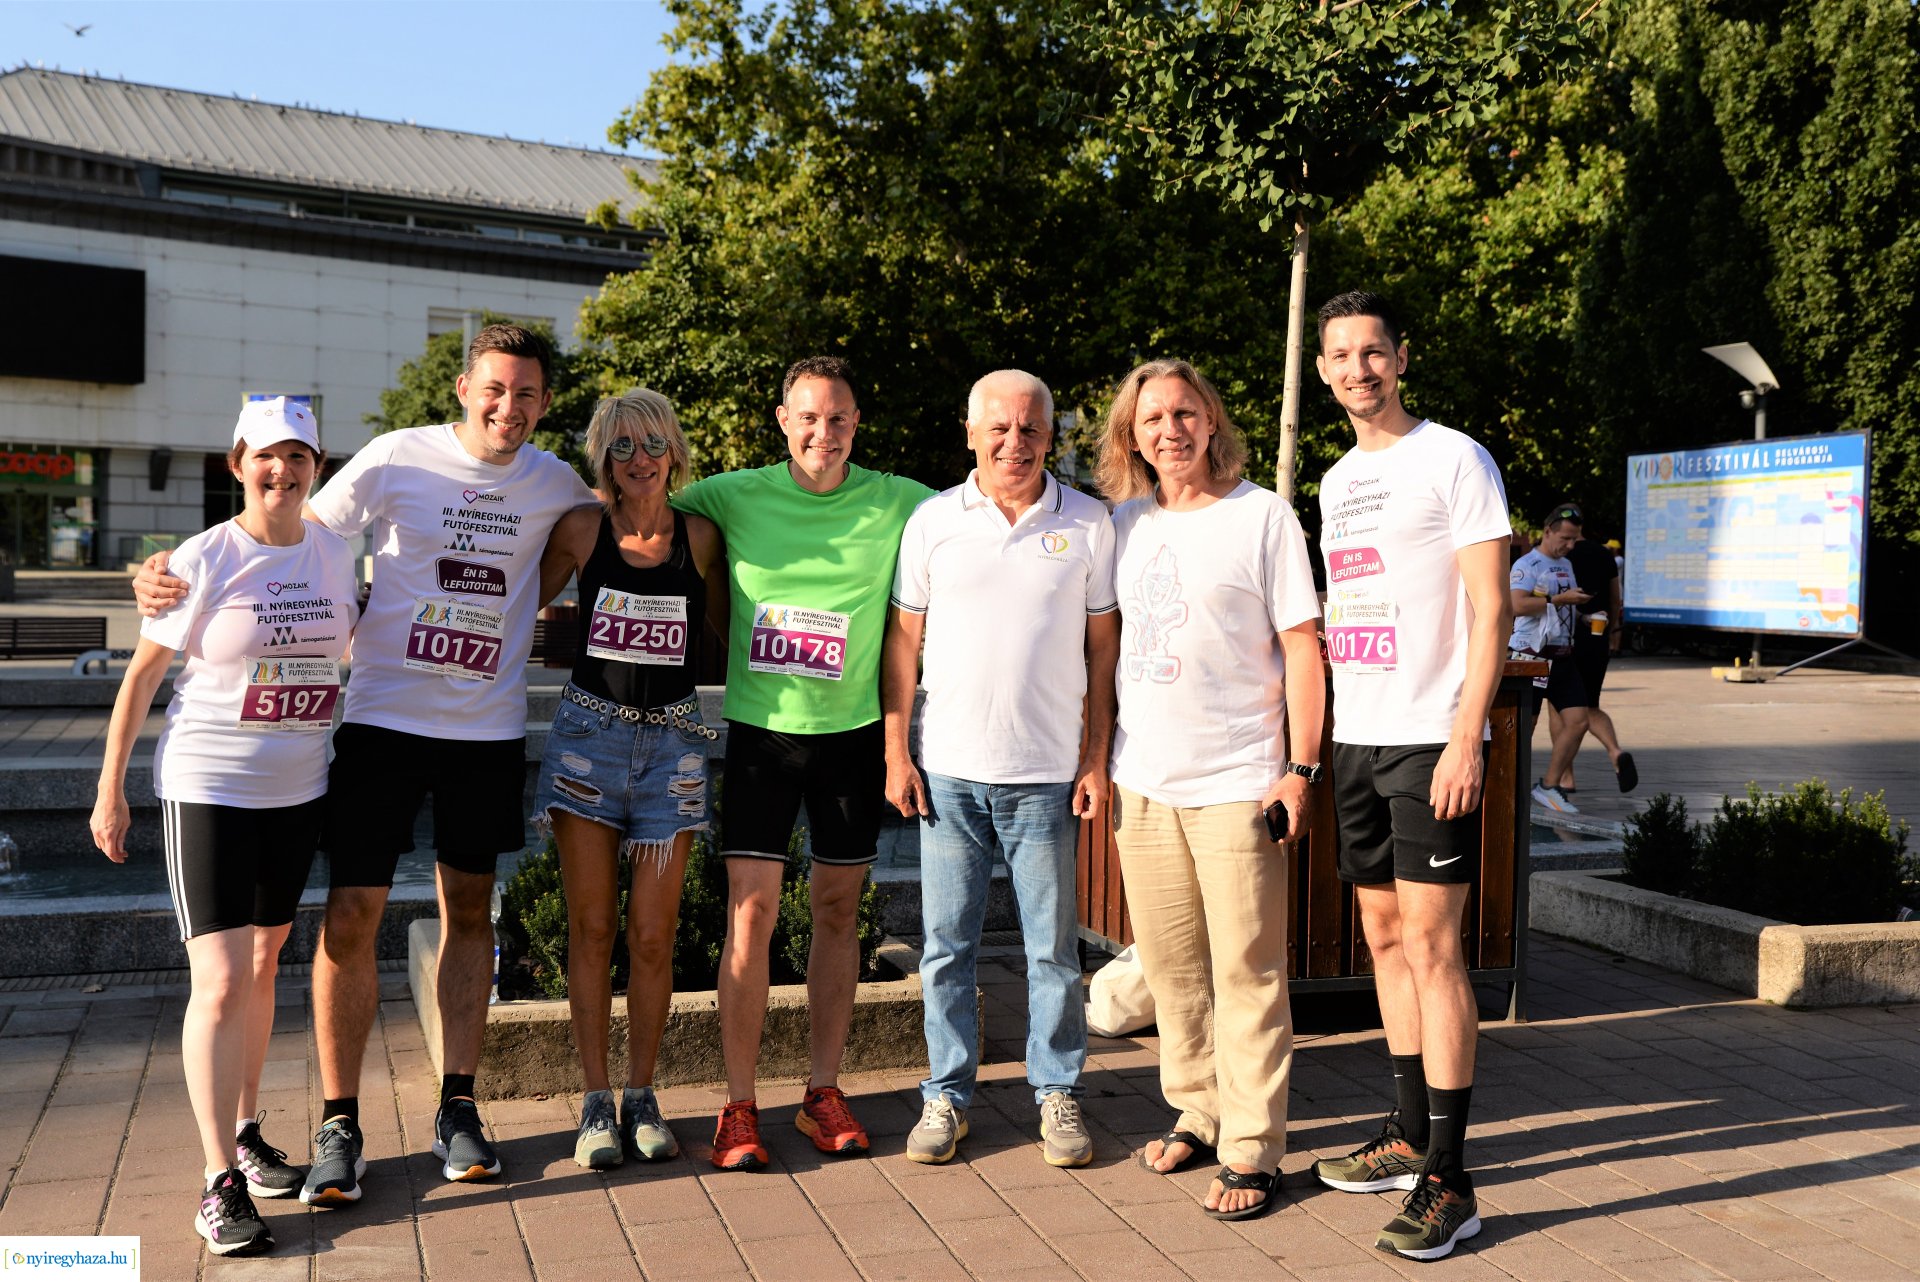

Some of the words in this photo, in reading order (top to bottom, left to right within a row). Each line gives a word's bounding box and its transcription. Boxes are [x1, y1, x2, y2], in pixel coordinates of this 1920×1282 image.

[1775, 445, 1829, 457] BELVÁROSI
[1633, 455, 1682, 480] VIDOR
[1687, 449, 1770, 473] FESZTIVÁL
[1774, 454, 1833, 467] PROGRAMJA
[478, 493, 504, 503] MOZAIK
[442, 507, 455, 517] III.
[458, 508, 522, 525] NYÍREGYHÁZI
[443, 519, 519, 537] FUTÓFESZTIVÁL
[1343, 553, 1354, 565] ÉN
[1355, 552, 1363, 561] IS
[463, 567, 476, 578] ÉN
[478, 569, 488, 579] IS
[1333, 562, 1380, 580] LEFUTOTTAM
[282, 581, 309, 591] MOZAIK
[444, 579, 504, 593] LEFUTOTTAM
[253, 602, 267, 613] III.
[269, 597, 333, 612] NYÍREGYHÁZI
[257, 609, 335, 625] FUTÓFESZTIVÁL
[593, 616, 684, 649] 21250
[414, 630, 499, 667] 10177
[756, 633, 842, 666] 10178
[1327, 632, 1394, 659] 10176
[255, 690, 328, 716] 5197
